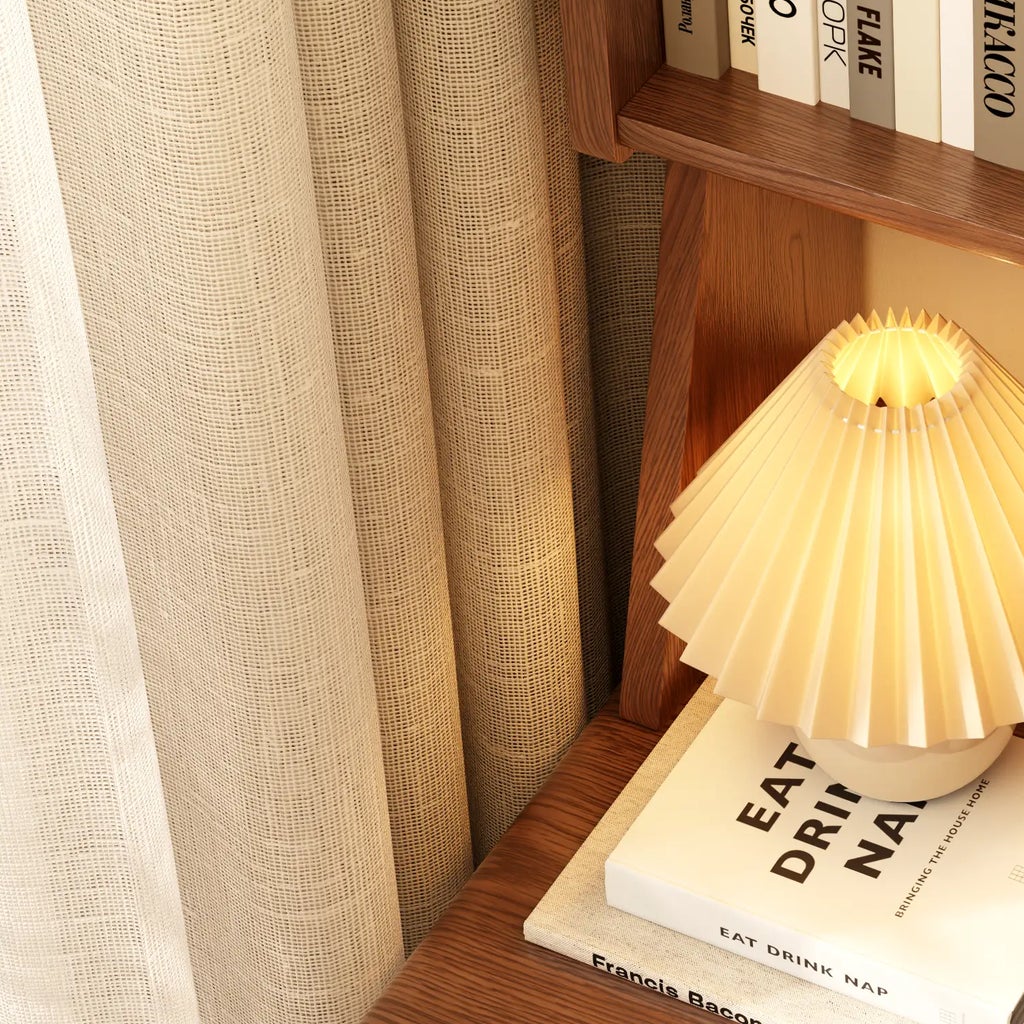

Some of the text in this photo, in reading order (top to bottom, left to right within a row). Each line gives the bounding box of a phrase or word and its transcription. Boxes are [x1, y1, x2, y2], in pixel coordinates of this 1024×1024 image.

[856, 4, 883, 80] FLAKE
[735, 741, 817, 833] EAT
[769, 782, 863, 885] DRI
[843, 800, 928, 880] NA
[894, 778, 991, 919] BRINGING THE HOUSE HOME
[592, 953, 679, 999] Francis
[719, 926, 889, 997] EAT DRINK NAP
